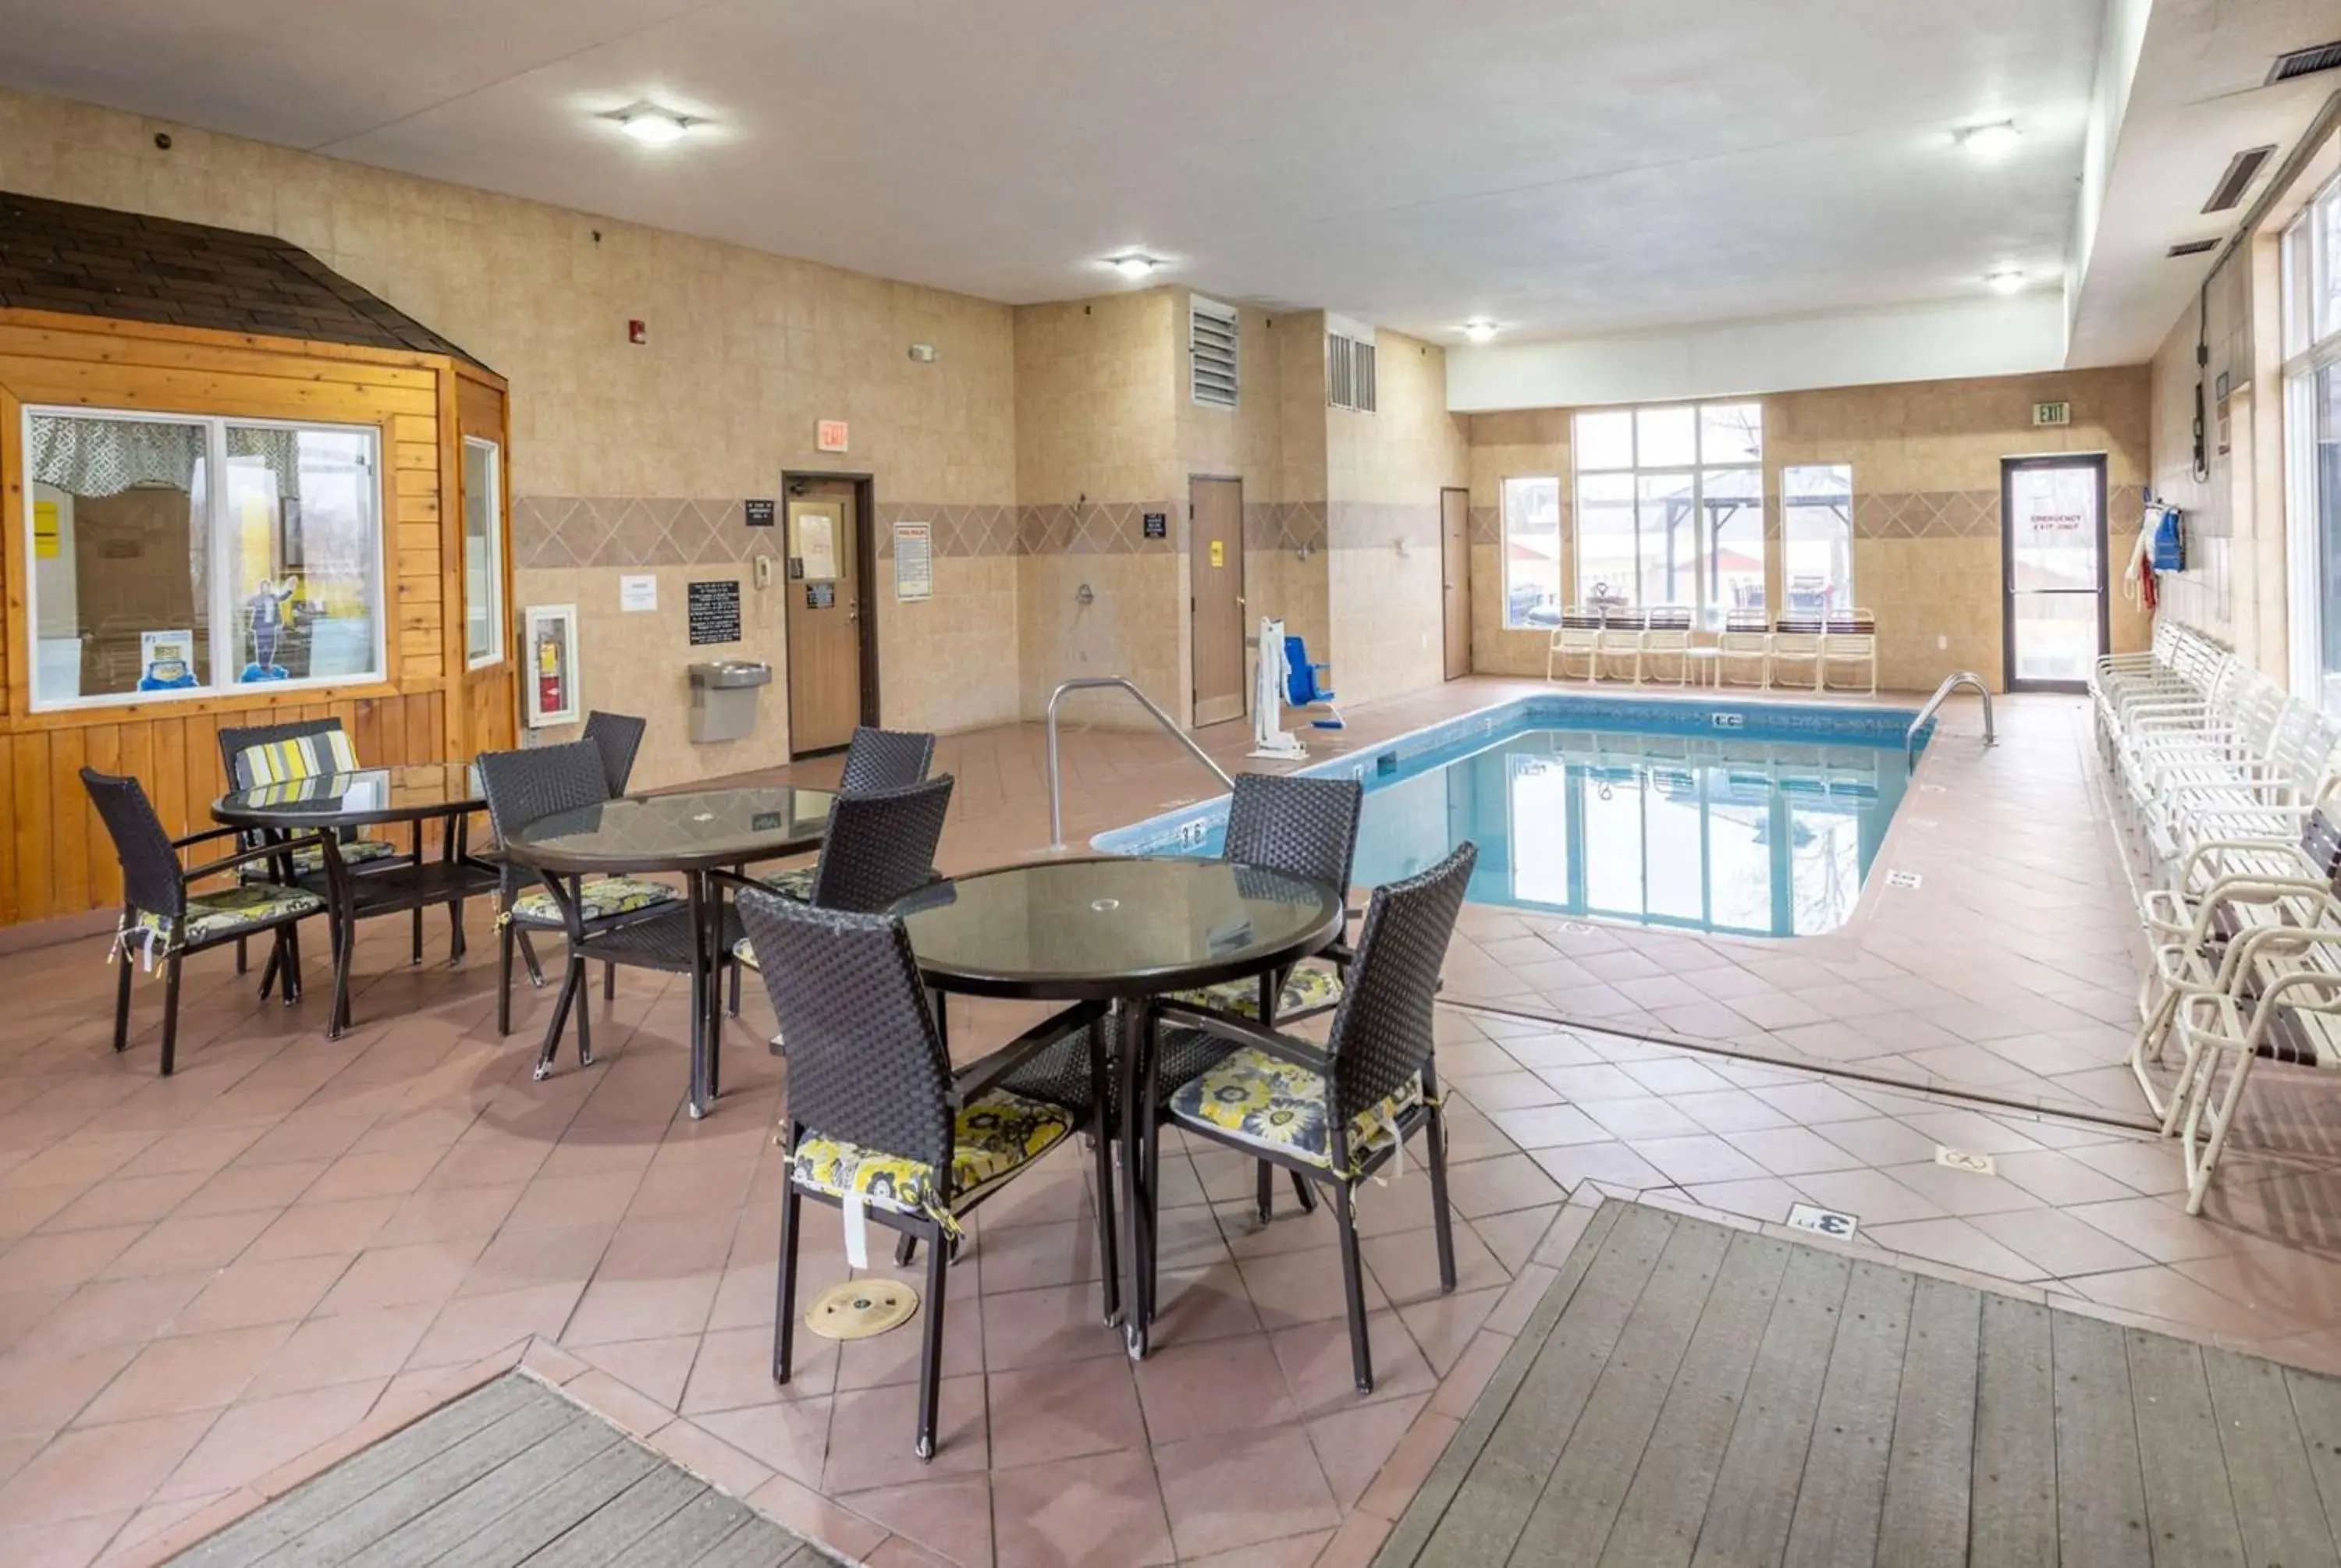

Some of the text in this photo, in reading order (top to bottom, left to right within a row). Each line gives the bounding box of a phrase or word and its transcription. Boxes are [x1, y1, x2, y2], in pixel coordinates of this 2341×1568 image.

[2040, 404, 2063, 423] EXIT
[823, 424, 845, 445] EXIT
[1819, 1215, 1850, 1235] 3
